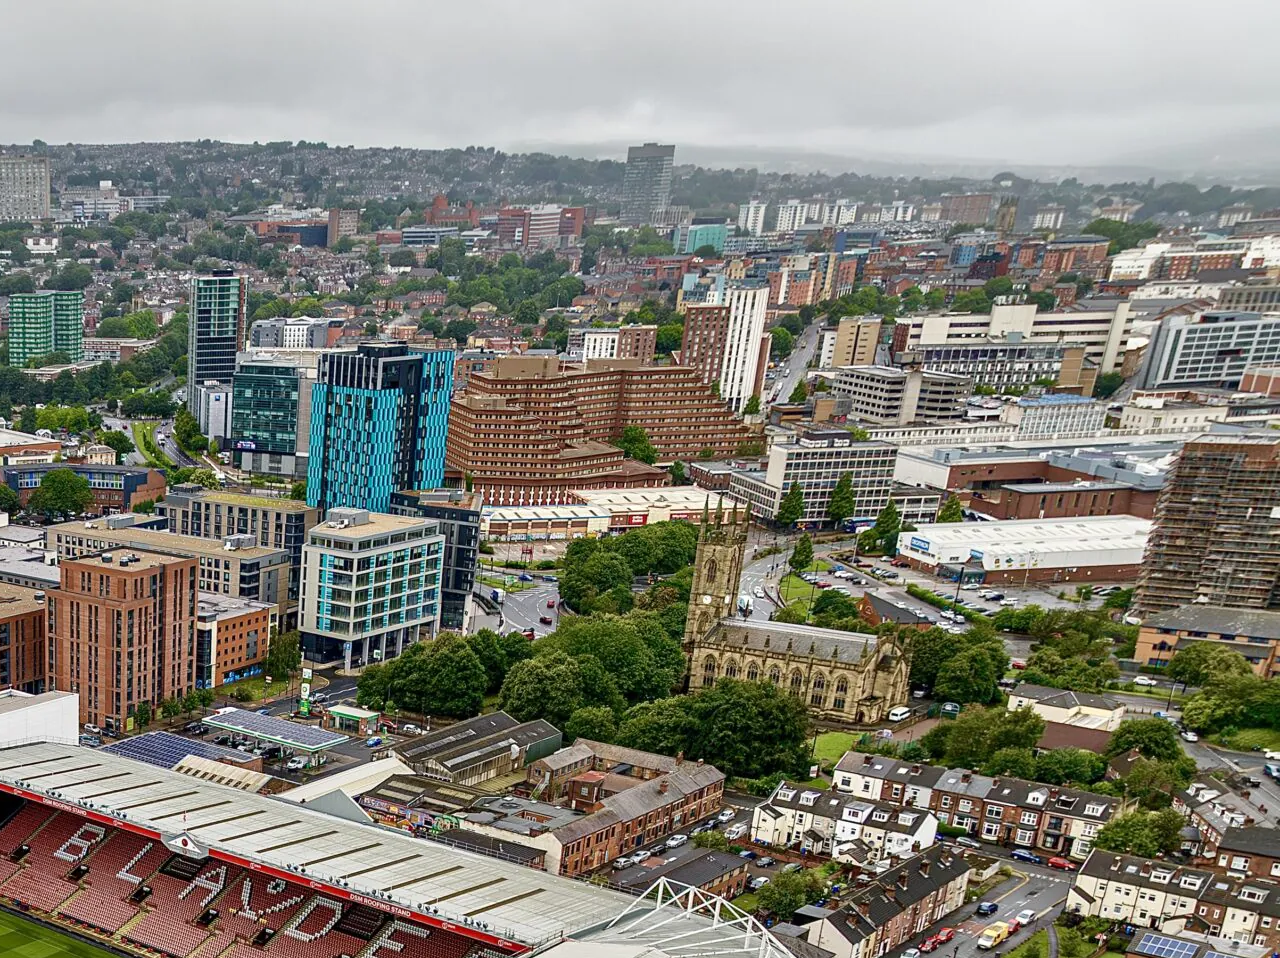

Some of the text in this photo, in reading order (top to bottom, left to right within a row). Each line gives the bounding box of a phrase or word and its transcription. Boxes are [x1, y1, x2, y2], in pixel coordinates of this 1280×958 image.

[350, 893, 411, 917] DSM ROOFING STAND
